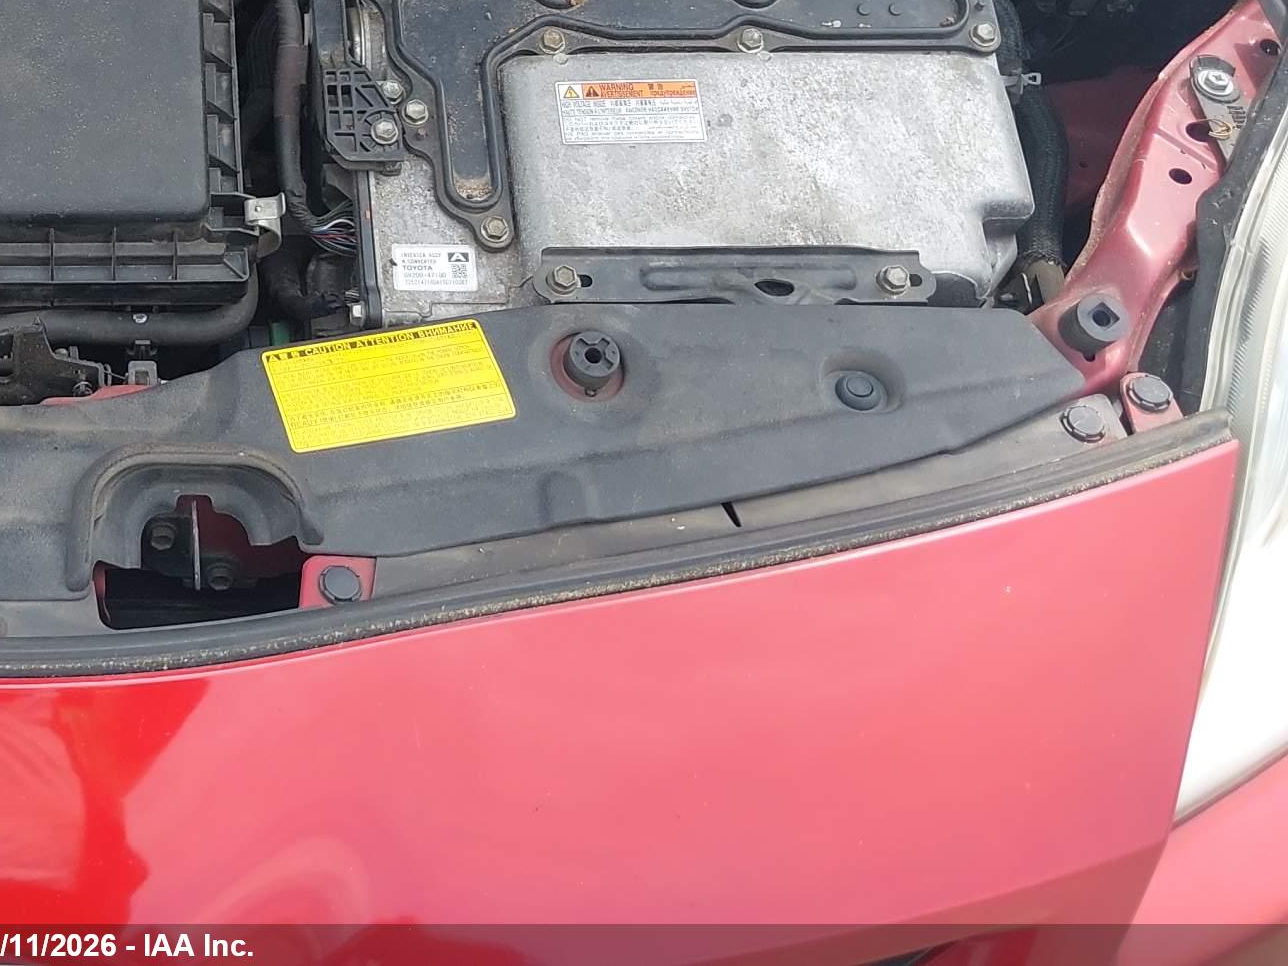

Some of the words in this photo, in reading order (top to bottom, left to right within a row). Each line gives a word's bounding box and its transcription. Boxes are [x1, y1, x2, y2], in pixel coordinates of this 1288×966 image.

[599, 83, 634, 91] WARNING
[305, 342, 350, 355] CAUTION
[355, 332, 414, 348] ATTENTION
[419, 322, 476, 338] ВНИМАНИЕ
